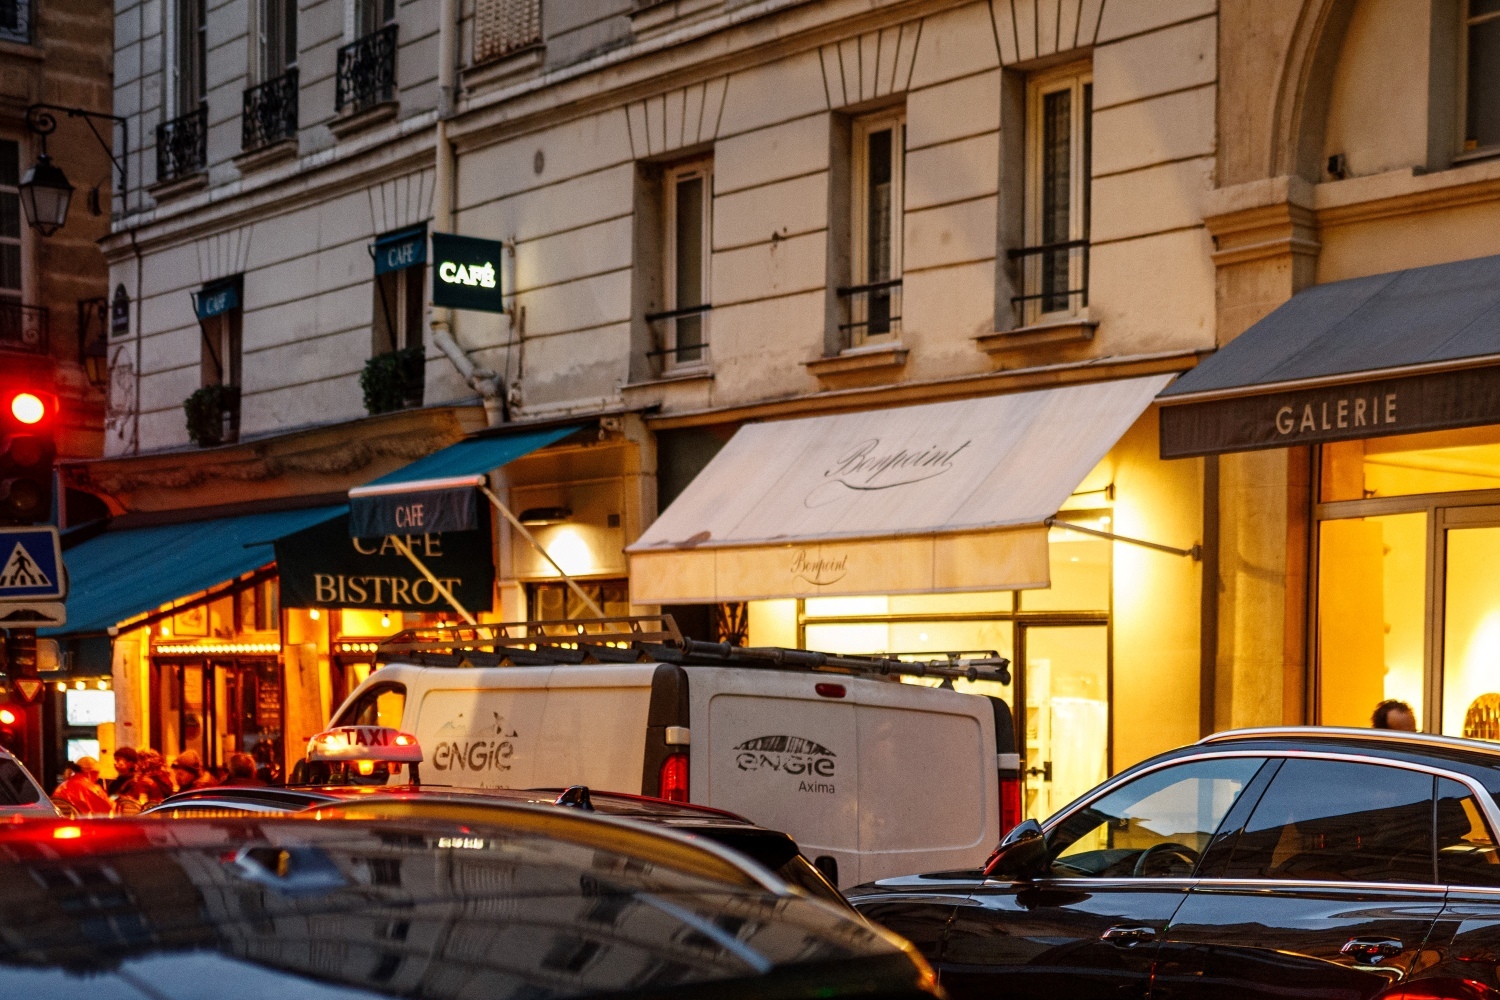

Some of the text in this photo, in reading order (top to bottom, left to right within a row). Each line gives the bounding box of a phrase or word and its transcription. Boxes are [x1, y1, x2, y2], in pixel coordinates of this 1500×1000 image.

[439, 261, 496, 288] CAFÉ
[1275, 393, 1397, 435] GALERIE
[818, 438, 972, 491] Bonpoint
[790, 550, 848, 585] Bonpoint
[313, 573, 462, 605] BISTROT
[341, 728, 389, 746] TAXI
[798, 780, 835, 794] Axima
